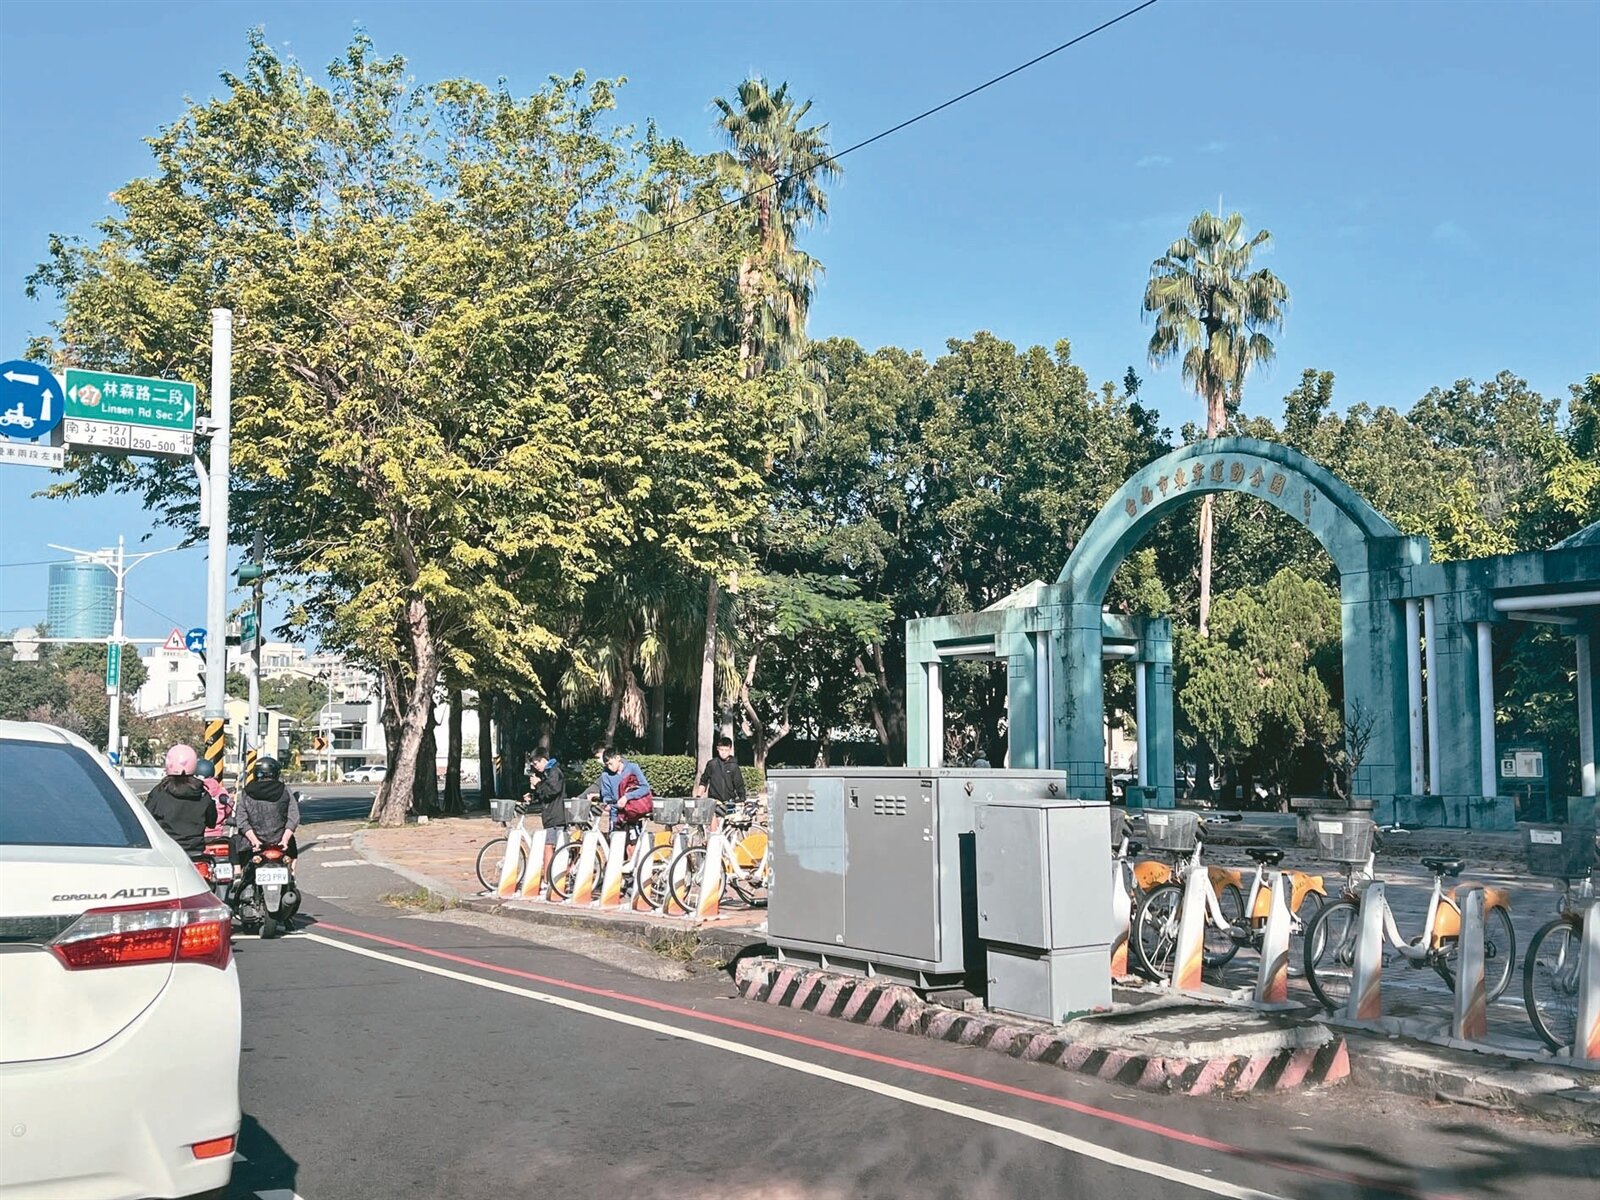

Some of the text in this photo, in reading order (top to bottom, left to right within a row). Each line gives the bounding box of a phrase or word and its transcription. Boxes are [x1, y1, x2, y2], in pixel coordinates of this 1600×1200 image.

[102, 380, 184, 406] 林森路二段
[101, 403, 134, 417] Linsen
[138, 407, 151, 418] Rd
[51, 886, 171, 902] COROLLA ALTIS
